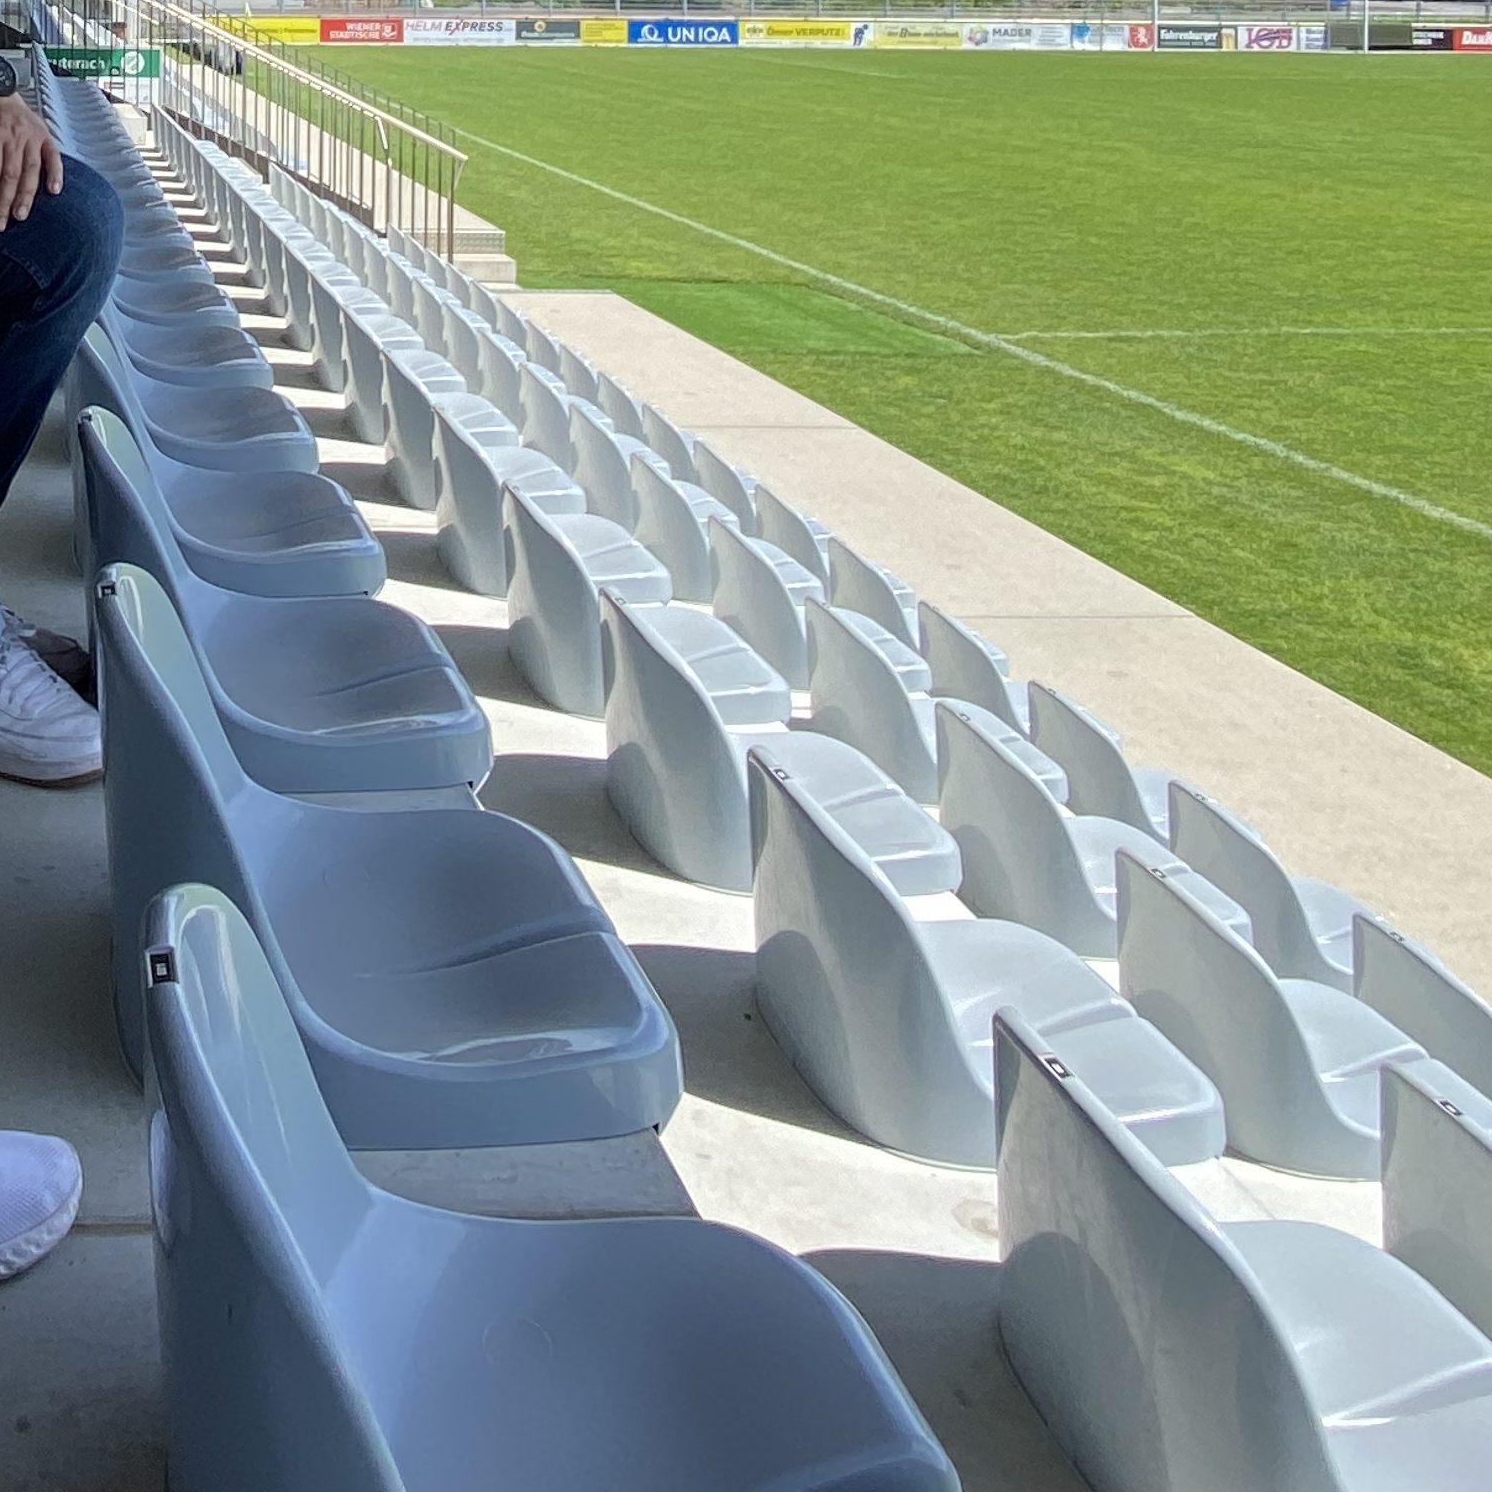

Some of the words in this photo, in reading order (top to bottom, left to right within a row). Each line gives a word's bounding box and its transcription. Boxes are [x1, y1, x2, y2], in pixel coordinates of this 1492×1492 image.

[405, 21, 442, 32] HELM
[444, 19, 504, 35] EXPRESS
[667, 27, 731, 43] UNIQA
[992, 28, 1032, 37] MADER
